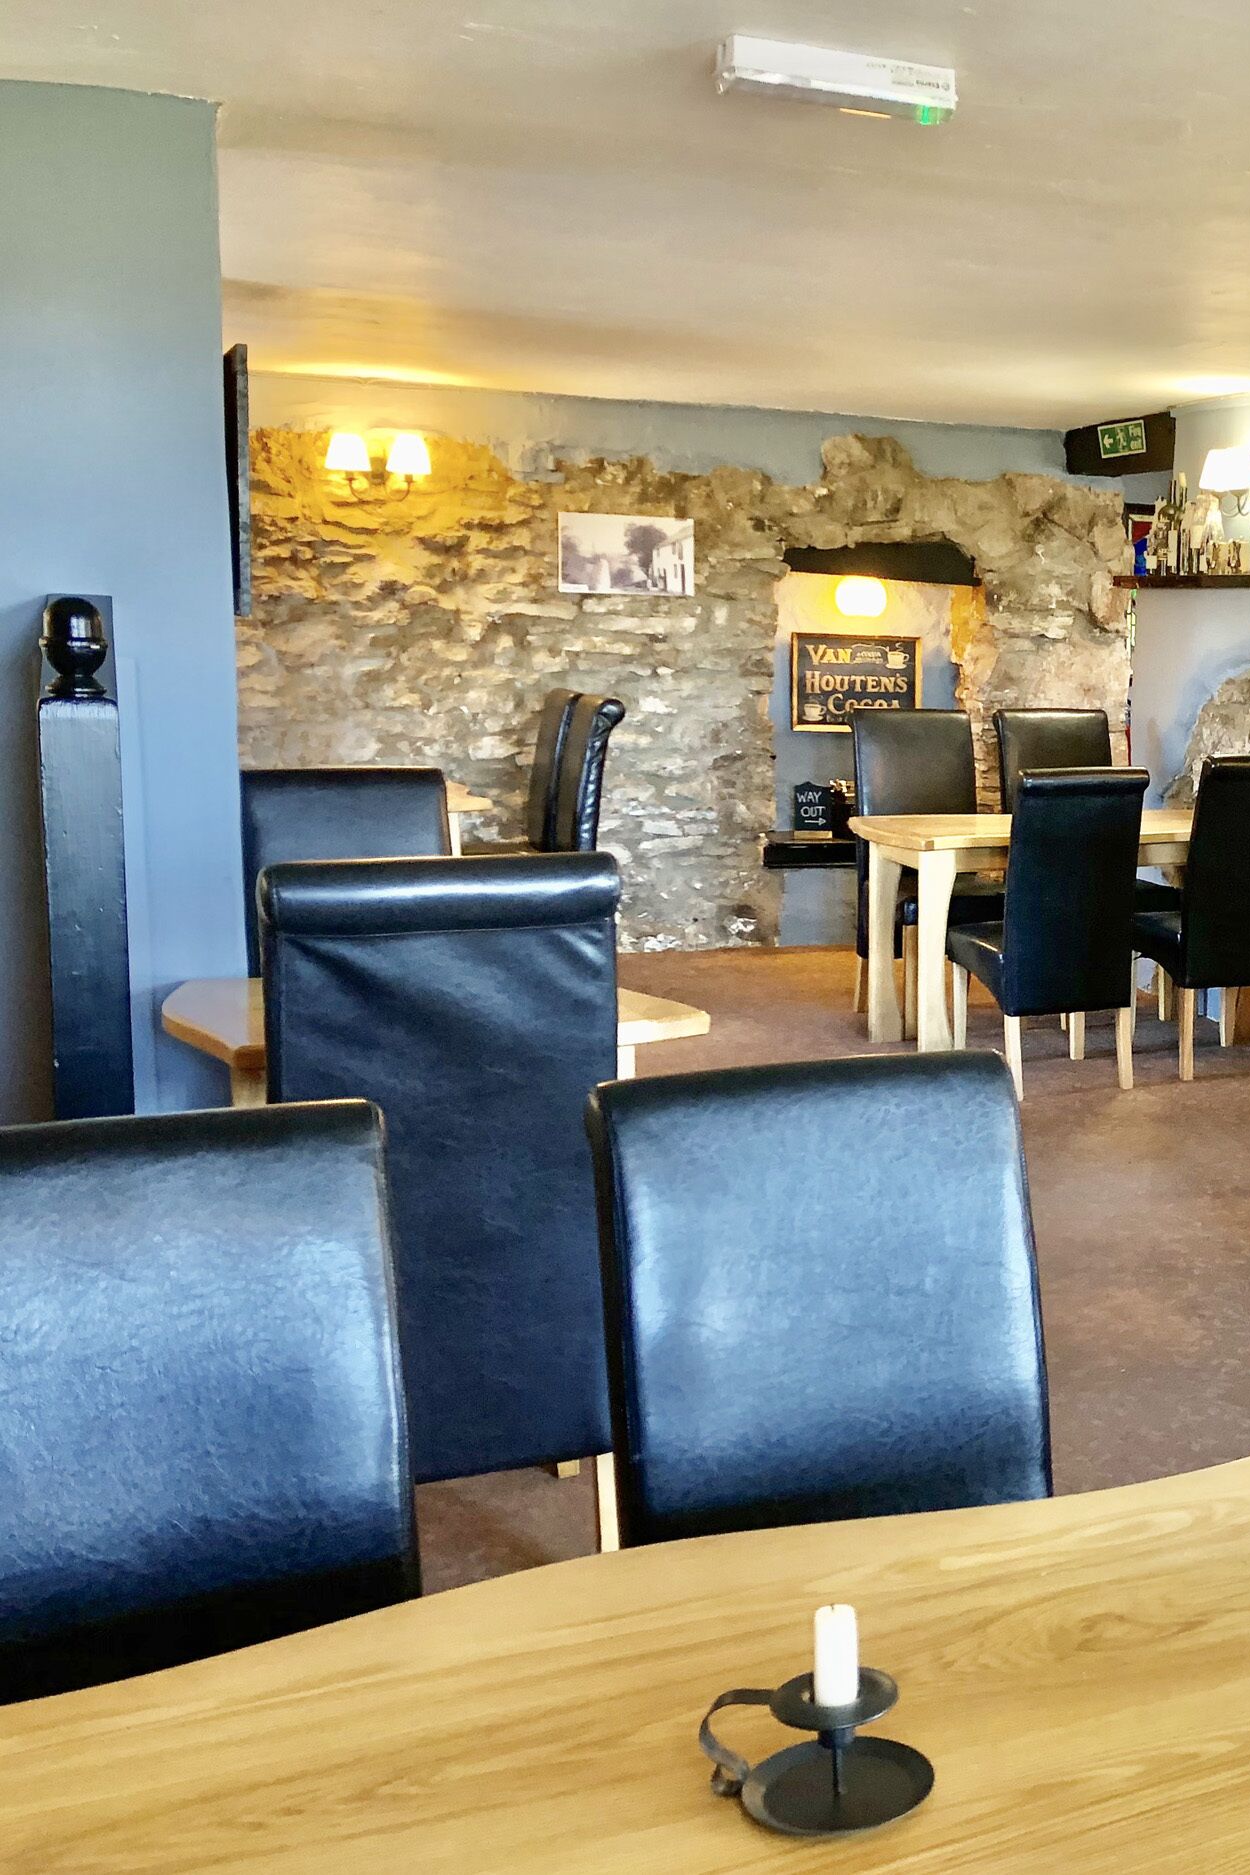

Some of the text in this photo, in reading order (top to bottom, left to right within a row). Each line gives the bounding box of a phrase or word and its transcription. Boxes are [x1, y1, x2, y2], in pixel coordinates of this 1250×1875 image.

[805, 644, 853, 666] VAN
[805, 670, 908, 694] HOUTEN'S
[796, 791, 822, 803] WAY
[800, 806, 826, 817] OUT
